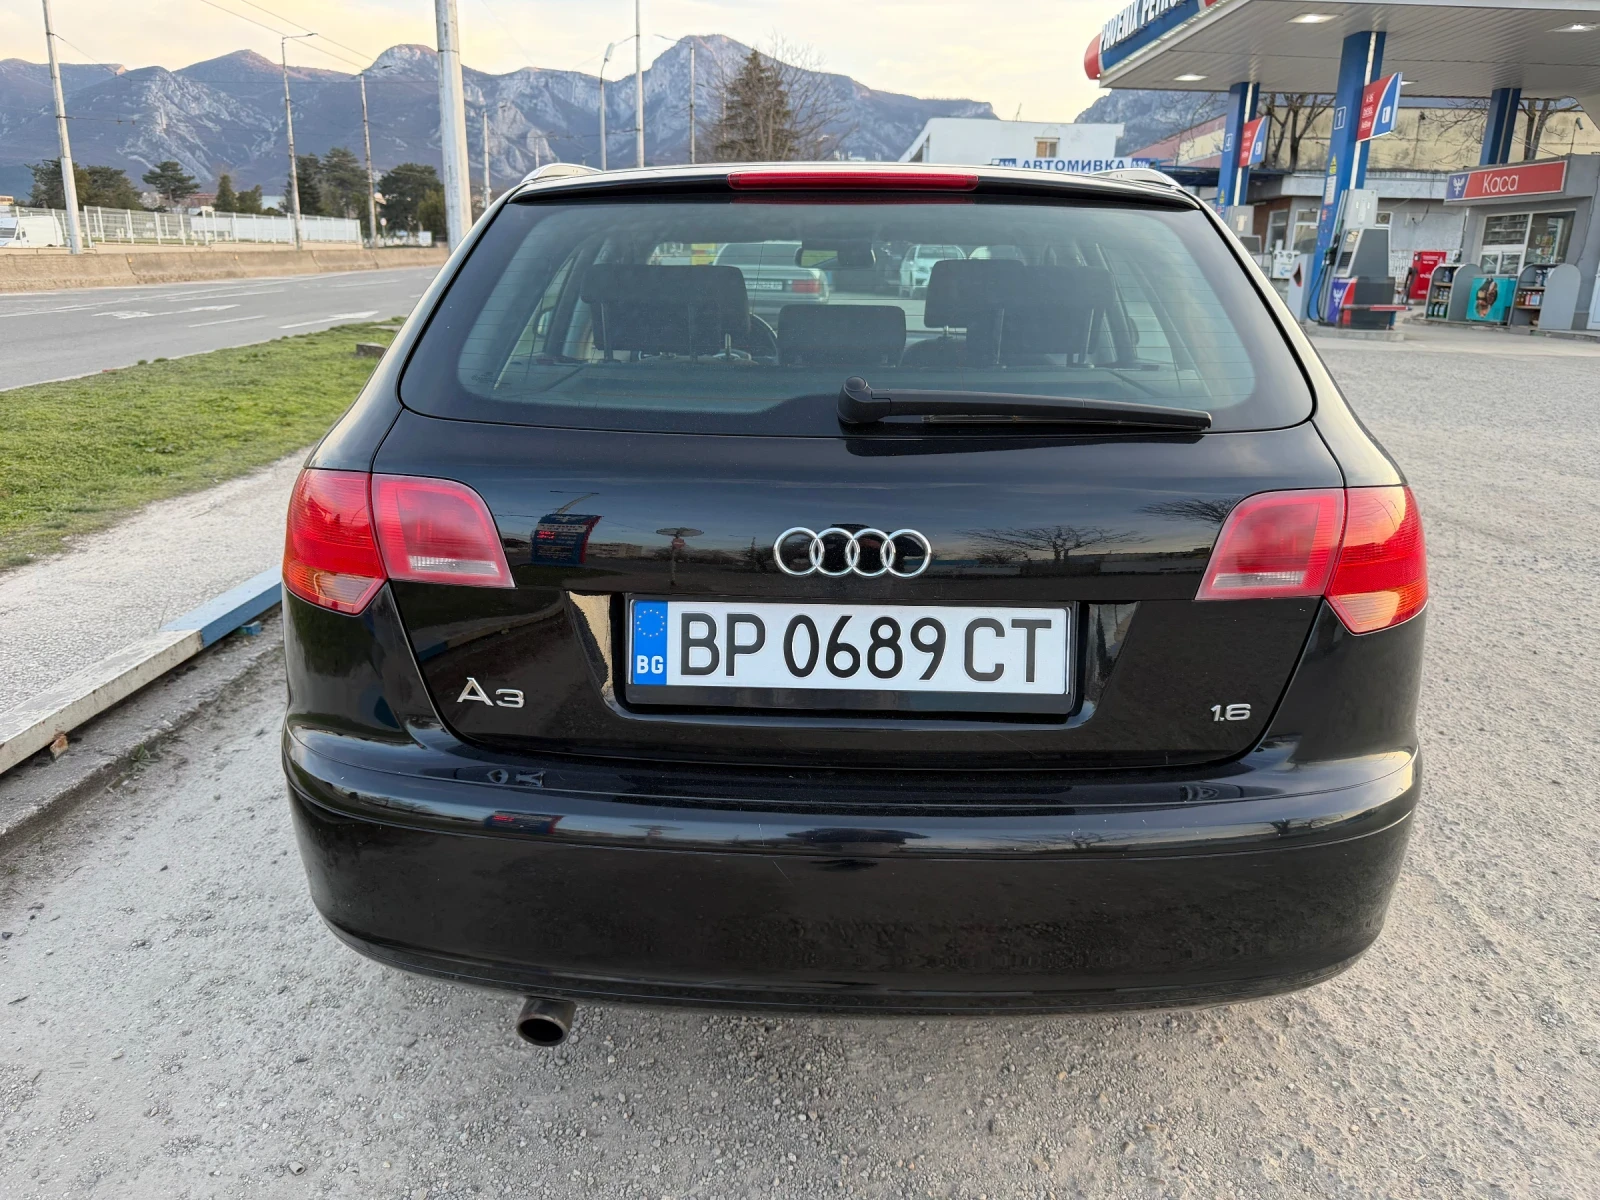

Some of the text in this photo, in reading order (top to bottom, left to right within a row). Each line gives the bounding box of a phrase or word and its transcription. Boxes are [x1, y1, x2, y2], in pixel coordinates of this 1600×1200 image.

[1099, 0, 1142, 54] PHOENIX
[1022, 159, 1125, 173] АВТОМИВКА
[1482, 173, 1519, 194] Каса
[681, 612, 1053, 683] BP 0689 CT
[636, 654, 664, 674] BG
[456, 676, 525, 708] A3
[1210, 703, 1252, 721] 1.6
